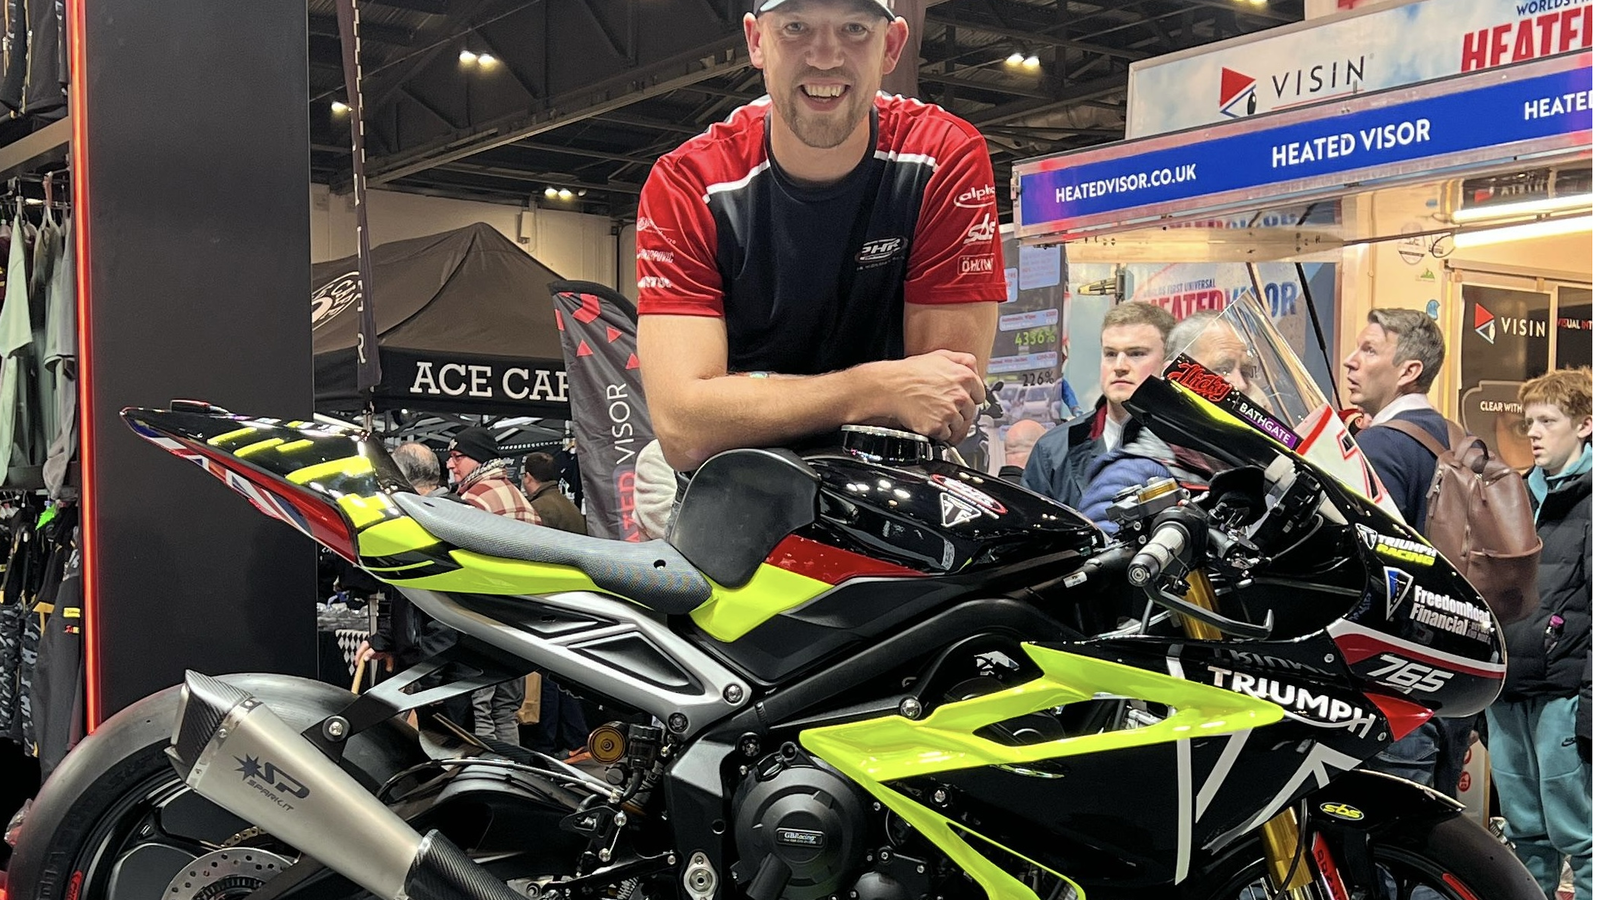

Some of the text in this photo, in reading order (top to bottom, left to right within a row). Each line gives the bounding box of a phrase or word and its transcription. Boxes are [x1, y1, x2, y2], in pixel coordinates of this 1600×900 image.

[1272, 56, 1365, 98] VISIN
[1272, 118, 1430, 168] HEATED VISOR
[1055, 163, 1197, 203] HEATEDVISOR.CO.UK
[1184, 278, 1216, 292] UNIVERSAL
[1501, 316, 1546, 338] VISIN
[1557, 319, 1581, 330] VISUAL
[409, 361, 493, 397] ACE
[1022, 369, 1055, 387] 226%
[606, 383, 636, 465] VISOR
[1480, 400, 1523, 414] CLEAR WITH
[1376, 543, 1436, 567] RACING
[1378, 534, 1437, 557] TRIUMPH
[1409, 603, 1469, 637] Financial
[1414, 584, 1490, 625] FreedomRoad
[1367, 653, 1454, 694] 765
[1207, 665, 1377, 740] TRIUMPH
[1322, 804, 1361, 820] sbs
